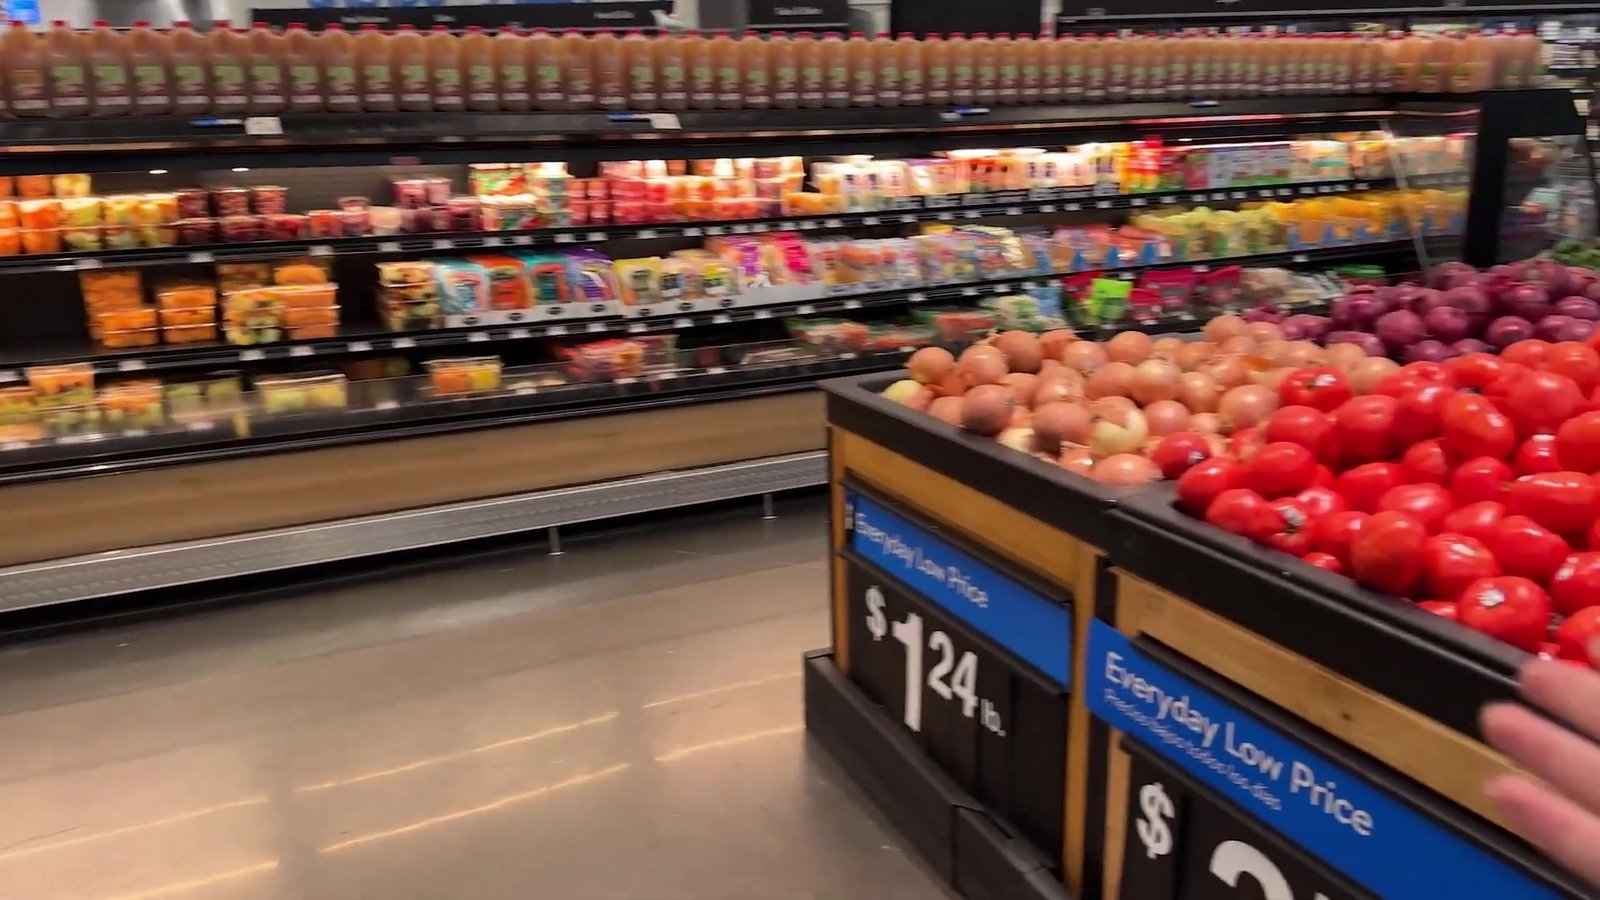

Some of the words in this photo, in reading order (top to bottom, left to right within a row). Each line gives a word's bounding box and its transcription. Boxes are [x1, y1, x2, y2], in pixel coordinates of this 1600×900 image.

[855, 512, 915, 569] Everyday
[914, 547, 946, 580] Low
[947, 566, 989, 608] Price
[864, 585, 888, 641] $
[892, 612, 924, 732] 1
[927, 630, 978, 718] 24
[1104, 651, 1220, 748] Everyday
[1225, 722, 1283, 780] Low
[1290, 760, 1374, 836] Price
[1136, 782, 1175, 859] $
